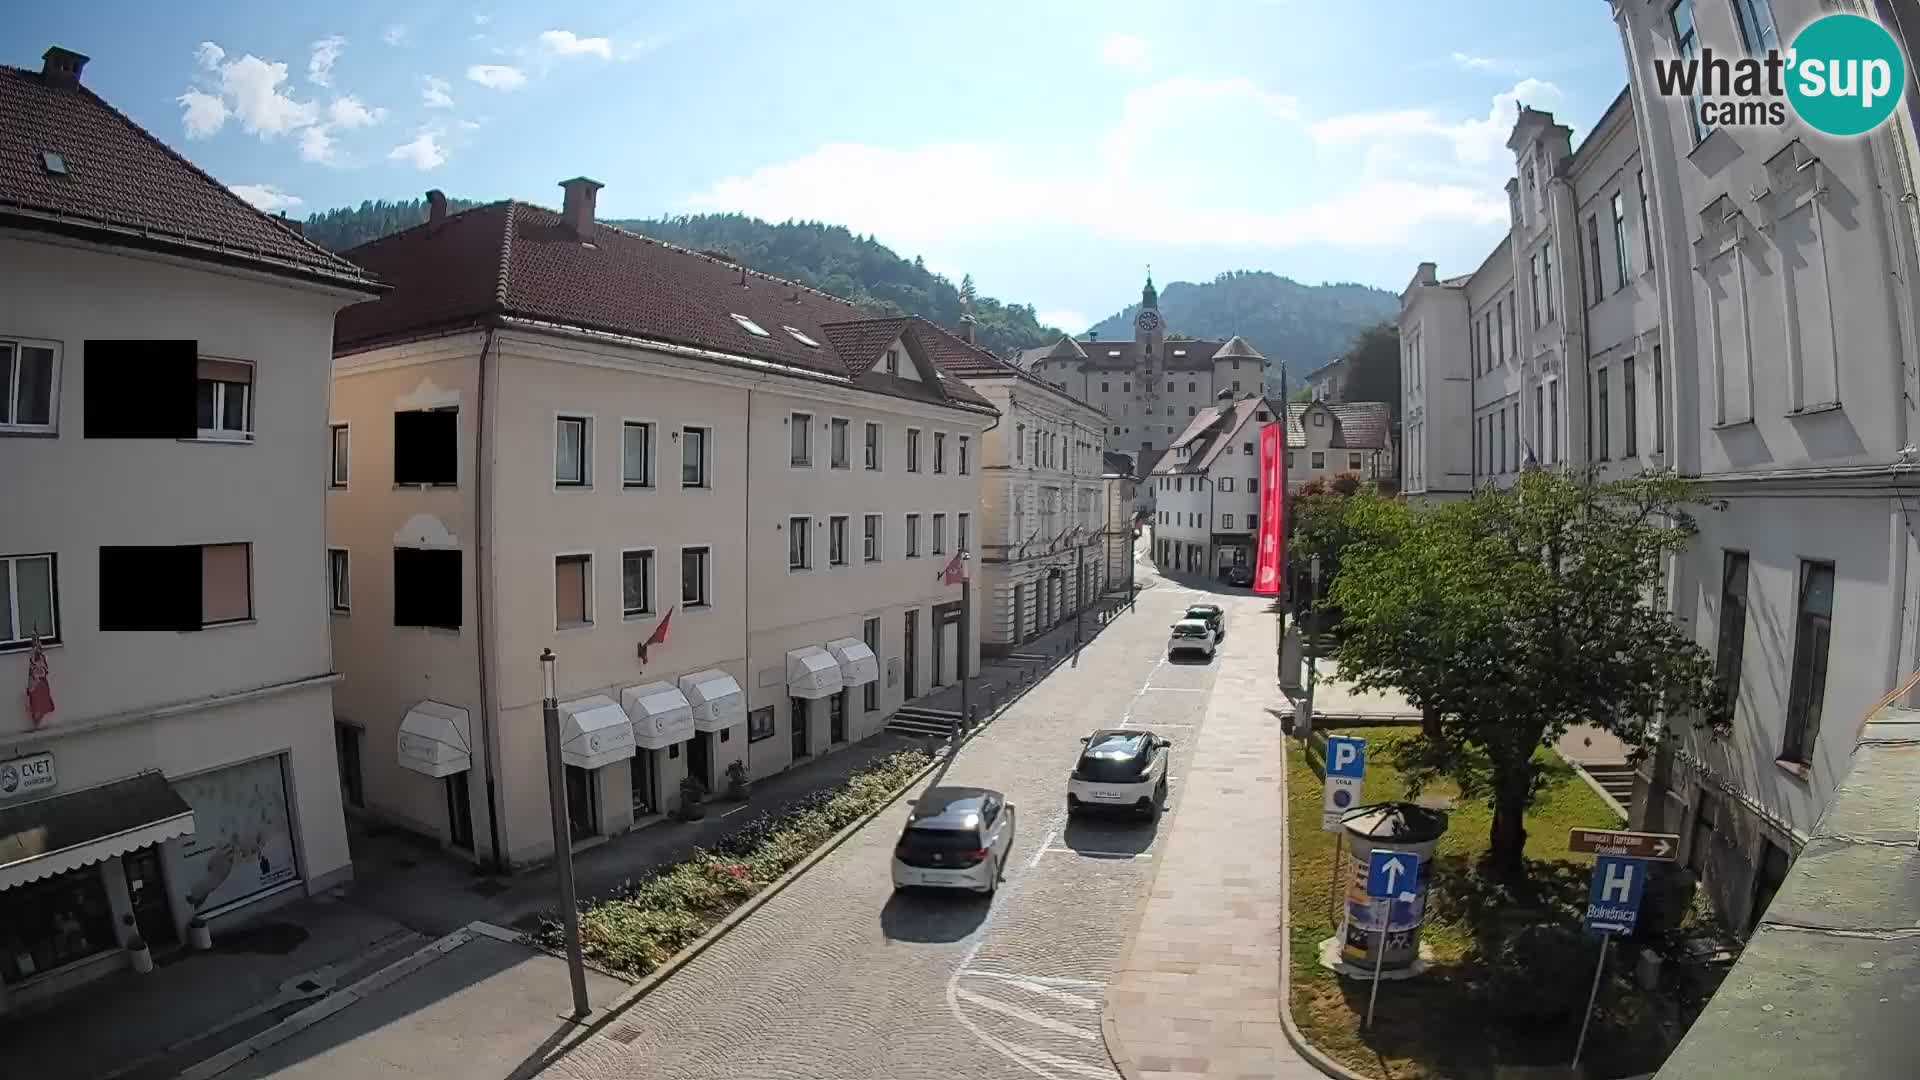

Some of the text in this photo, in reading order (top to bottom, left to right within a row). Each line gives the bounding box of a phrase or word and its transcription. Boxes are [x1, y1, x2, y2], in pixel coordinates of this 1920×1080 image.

[22, 760, 49, 777] CVET
[1335, 743, 1356, 770] P
[1601, 863, 1634, 903] H
